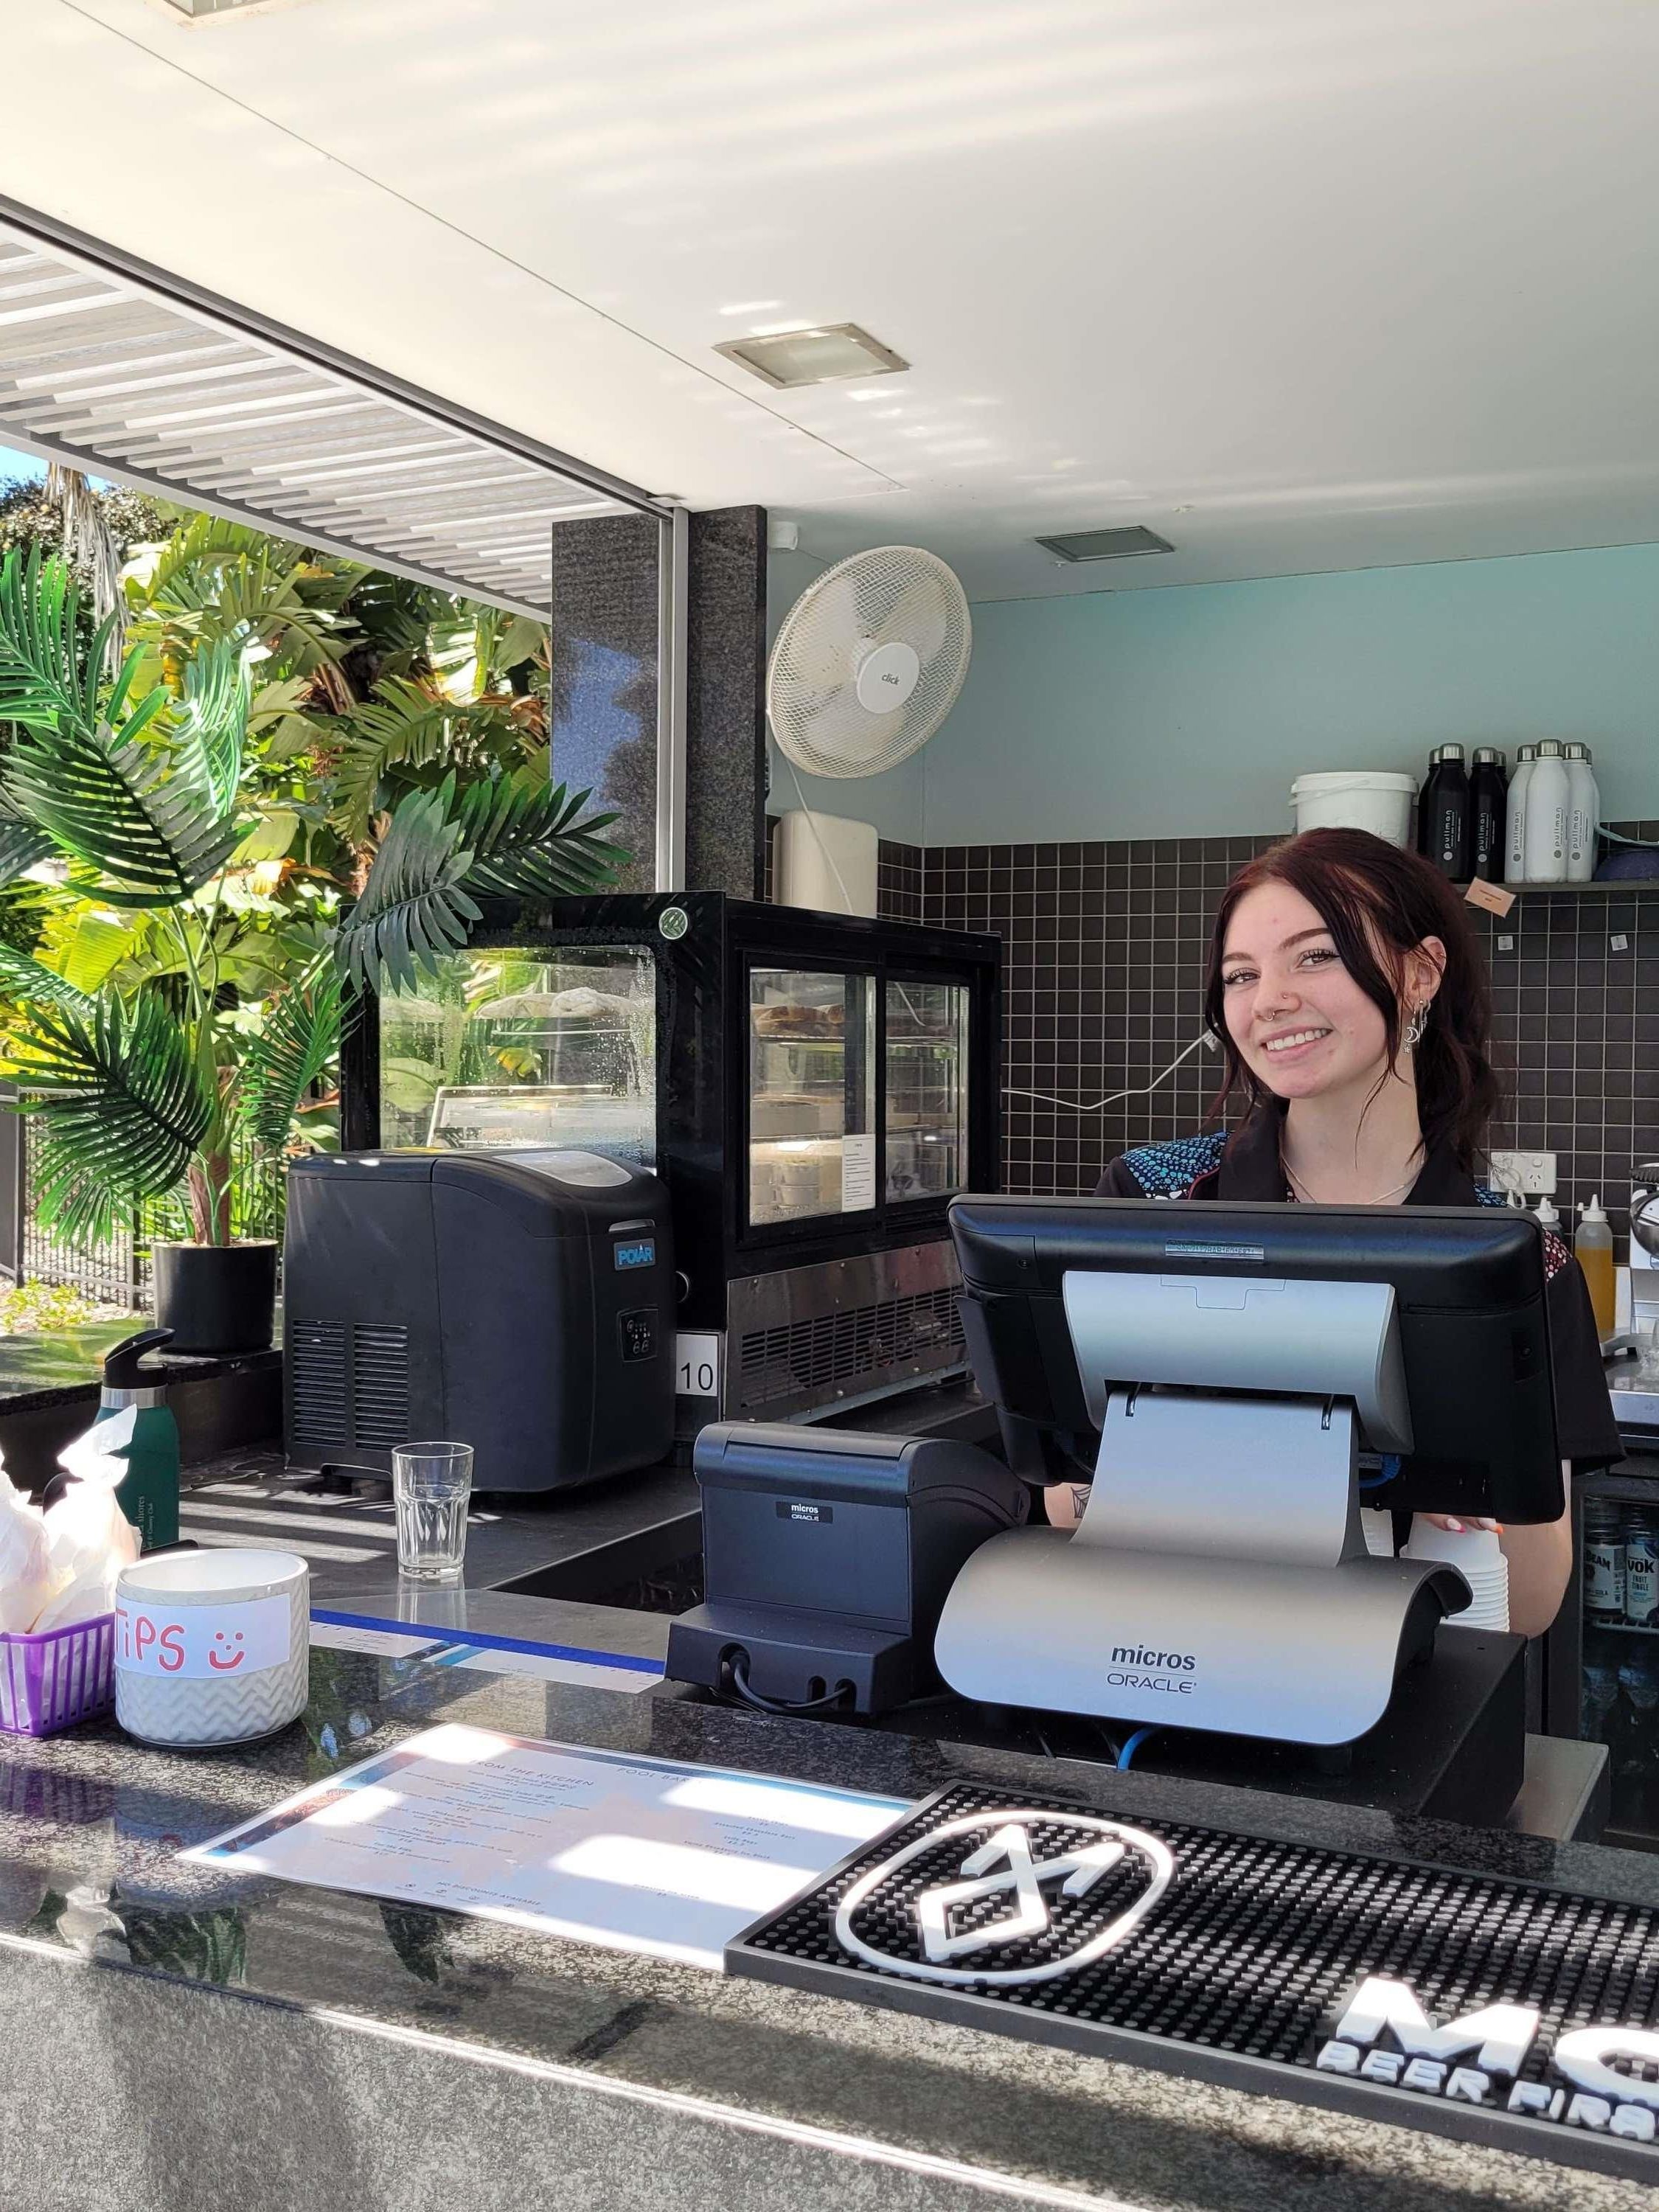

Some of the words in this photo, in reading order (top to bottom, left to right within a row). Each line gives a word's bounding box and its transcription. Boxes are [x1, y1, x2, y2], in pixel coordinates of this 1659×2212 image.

[881, 673, 900, 686] click
[1444, 810, 1453, 849] pullman
[1478, 813, 1487, 852] pullman
[1513, 812, 1521, 851] pullman
[1554, 807, 1562, 847] pullman
[1571, 810, 1582, 849] pullman
[618, 1245, 653, 1265] POLAR
[681, 1362, 714, 1391] 10
[790, 1503, 819, 1514] micros
[791, 1513, 819, 1522] ORACLE
[1110, 1644, 1196, 1671] micros
[1107, 1672, 1194, 1694] ORACLE
[538, 1773, 594, 1787] KITCHEN
[1315, 2040, 1490, 2104] BEER
